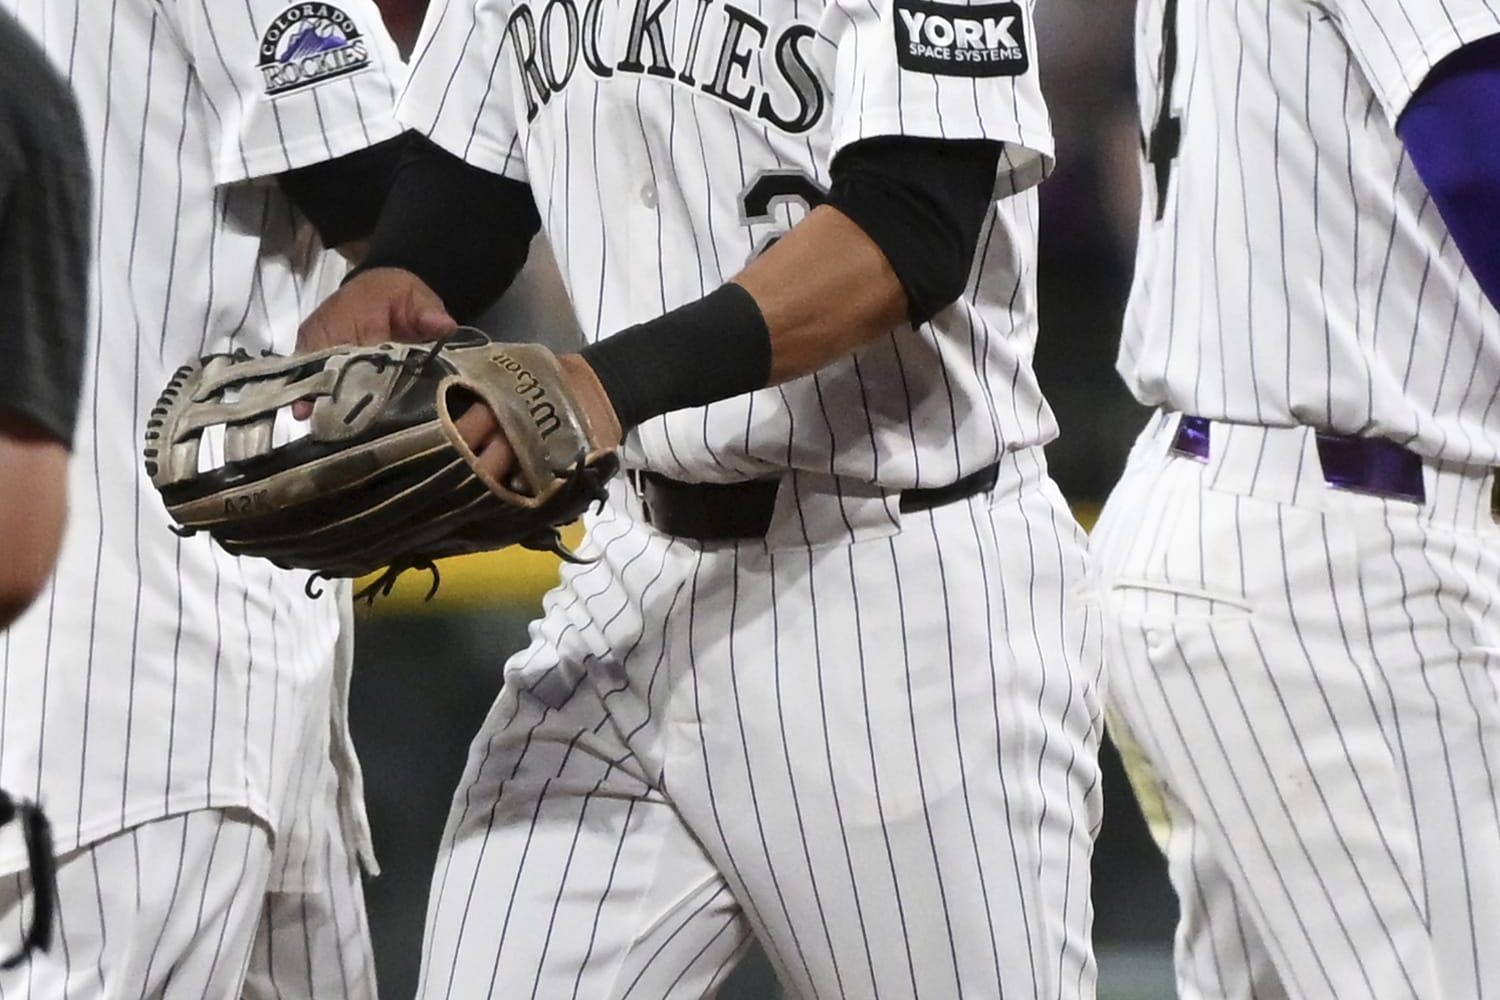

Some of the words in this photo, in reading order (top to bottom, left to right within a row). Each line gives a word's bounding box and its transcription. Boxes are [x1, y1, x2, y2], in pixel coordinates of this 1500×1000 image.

[262, 4, 355, 56] COLORADO
[898, 7, 1019, 50] YORK
[909, 43, 951, 60] SPACE
[954, 47, 1023, 62] SYSTEMS
[260, 39, 368, 90] ROCKIES
[491, 353, 561, 440] Wilson
